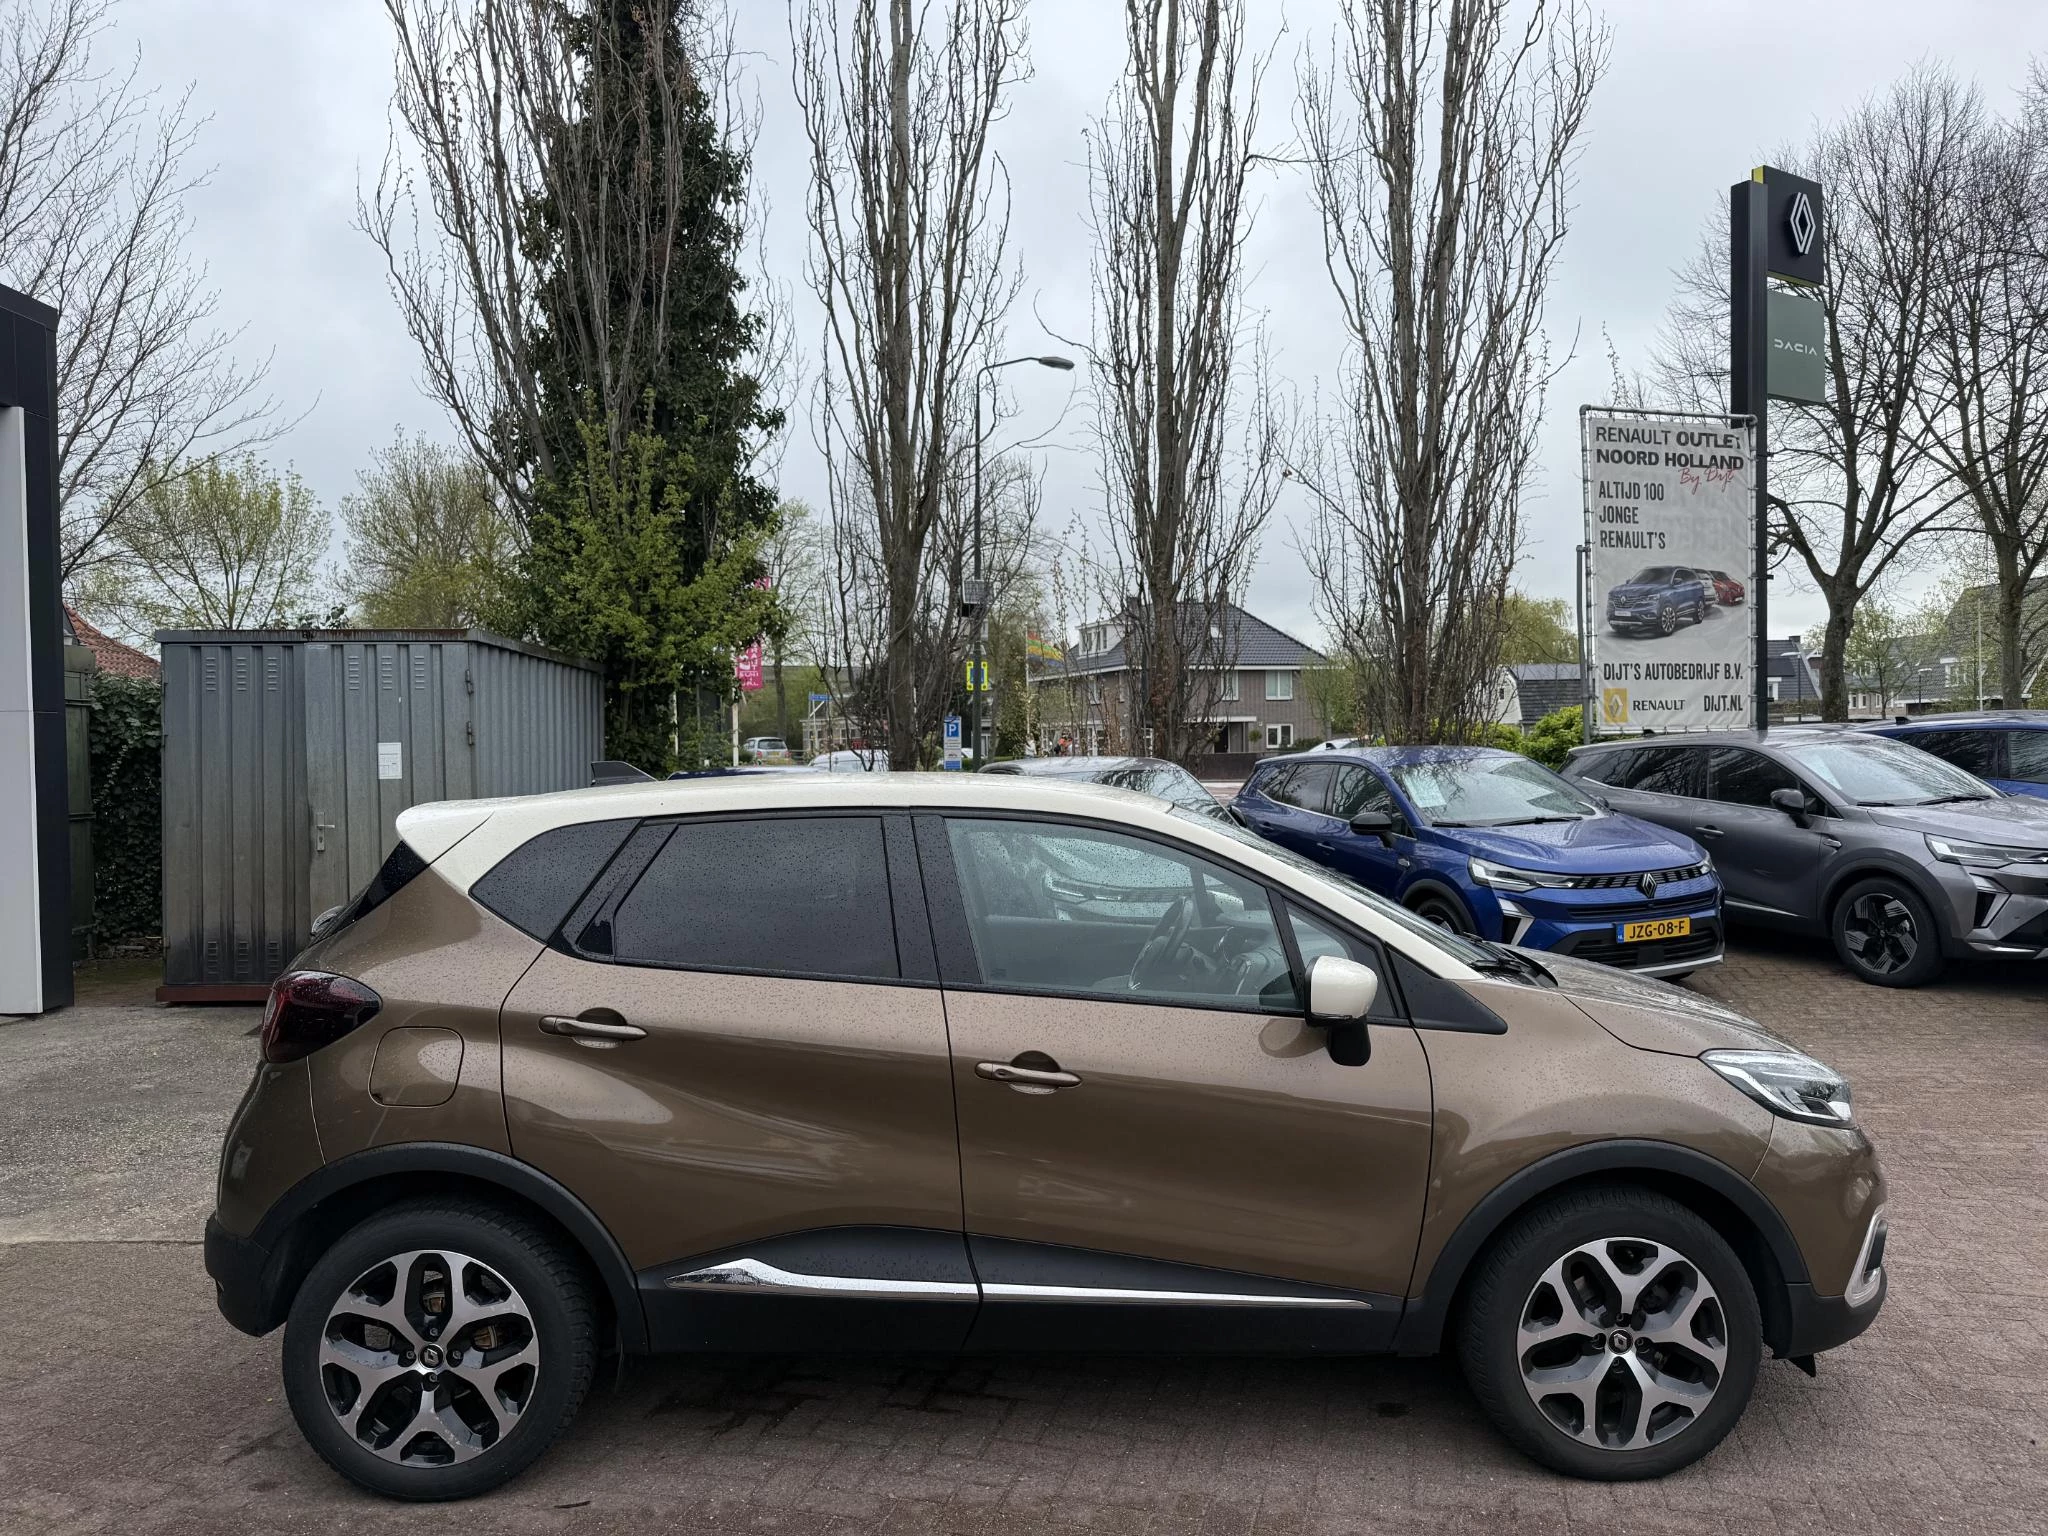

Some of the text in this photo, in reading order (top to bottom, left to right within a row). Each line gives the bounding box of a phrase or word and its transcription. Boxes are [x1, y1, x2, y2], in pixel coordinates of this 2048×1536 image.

[1774, 338, 1818, 356] DACIA
[1595, 426, 1671, 446] RENAULT
[1596, 448, 1744, 471] NOORD HOLLAND
[1598, 480, 1665, 501] ALTIJD 100
[1678, 467, 1702, 495] By
[1599, 505, 1640, 525] JONGE
[1599, 530, 1667, 550] RENAULT'S
[1603, 662, 1744, 681] DIJT'S AUTOBEDRIJF B.V.
[1632, 699, 1686, 712] RENAULT
[1703, 694, 1744, 713] DIJT.NL
[948, 723, 957, 737] P
[1629, 920, 1686, 939] JZG-08-F
